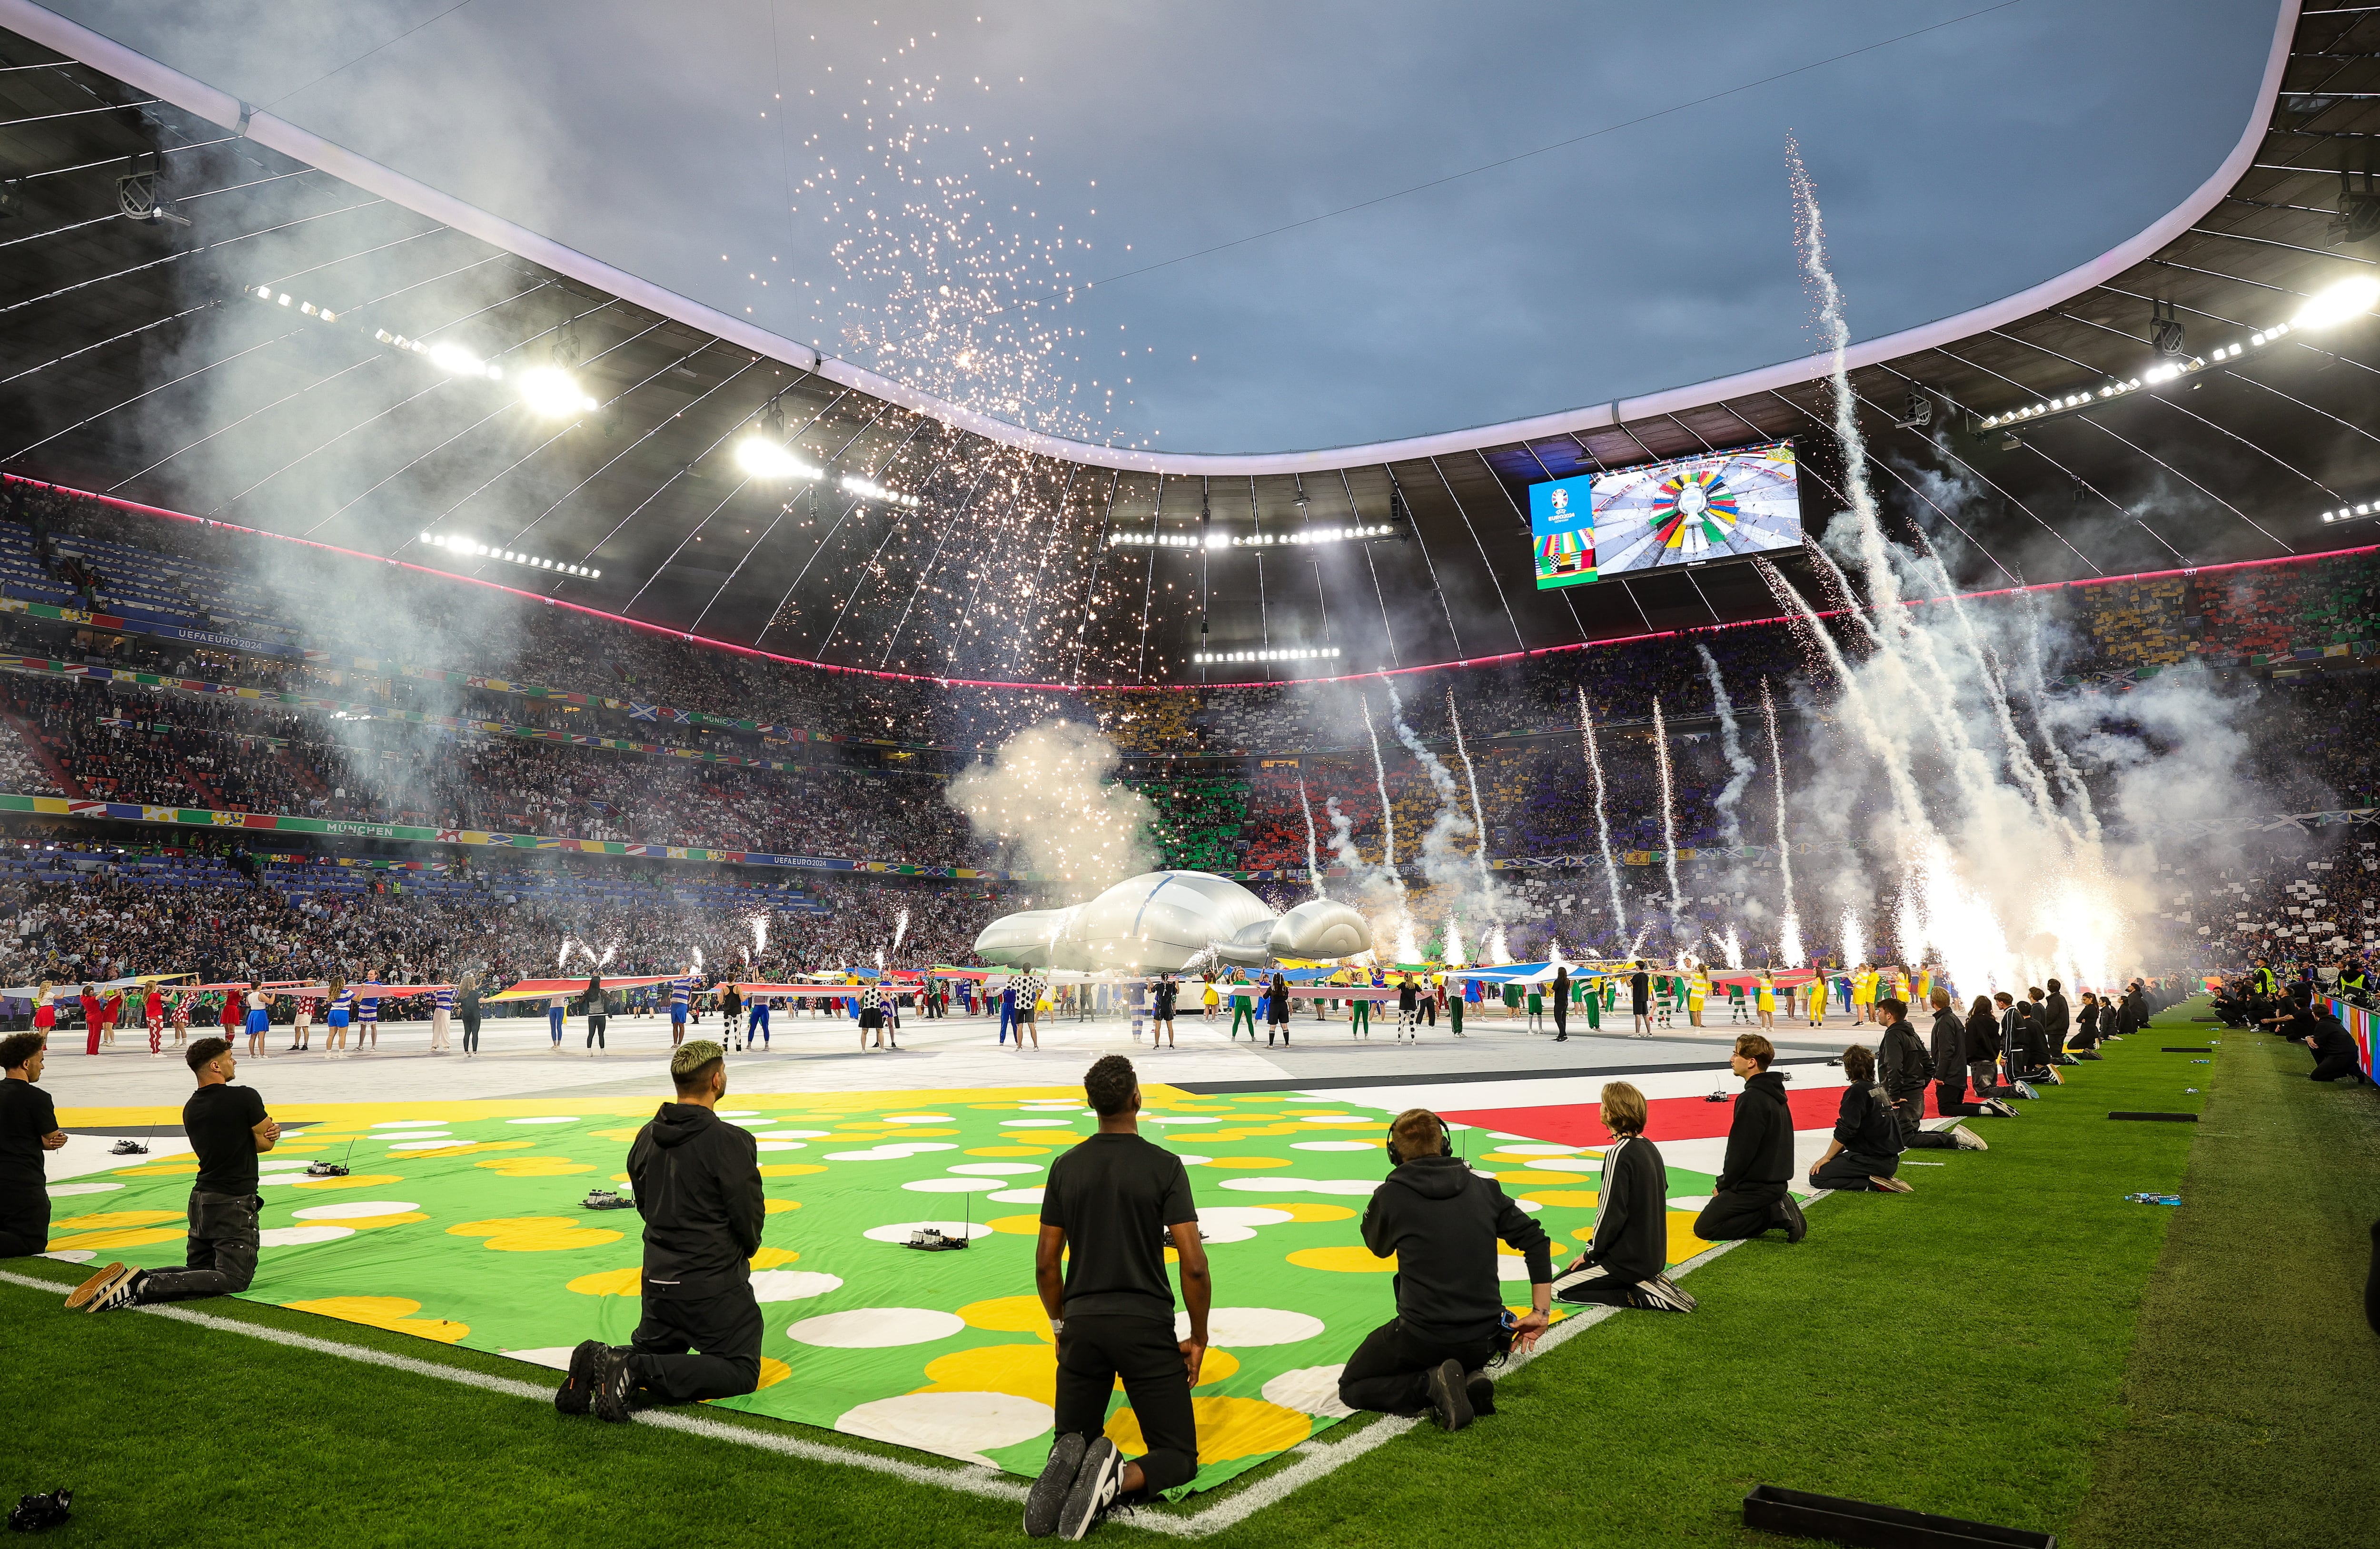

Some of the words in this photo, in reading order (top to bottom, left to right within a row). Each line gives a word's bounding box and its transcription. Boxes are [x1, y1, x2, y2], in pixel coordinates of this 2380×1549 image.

[1548, 513, 1575, 521] EURO2024
[703, 715, 727, 724] MUNIC
[327, 822, 393, 836] MÜNCHEN
